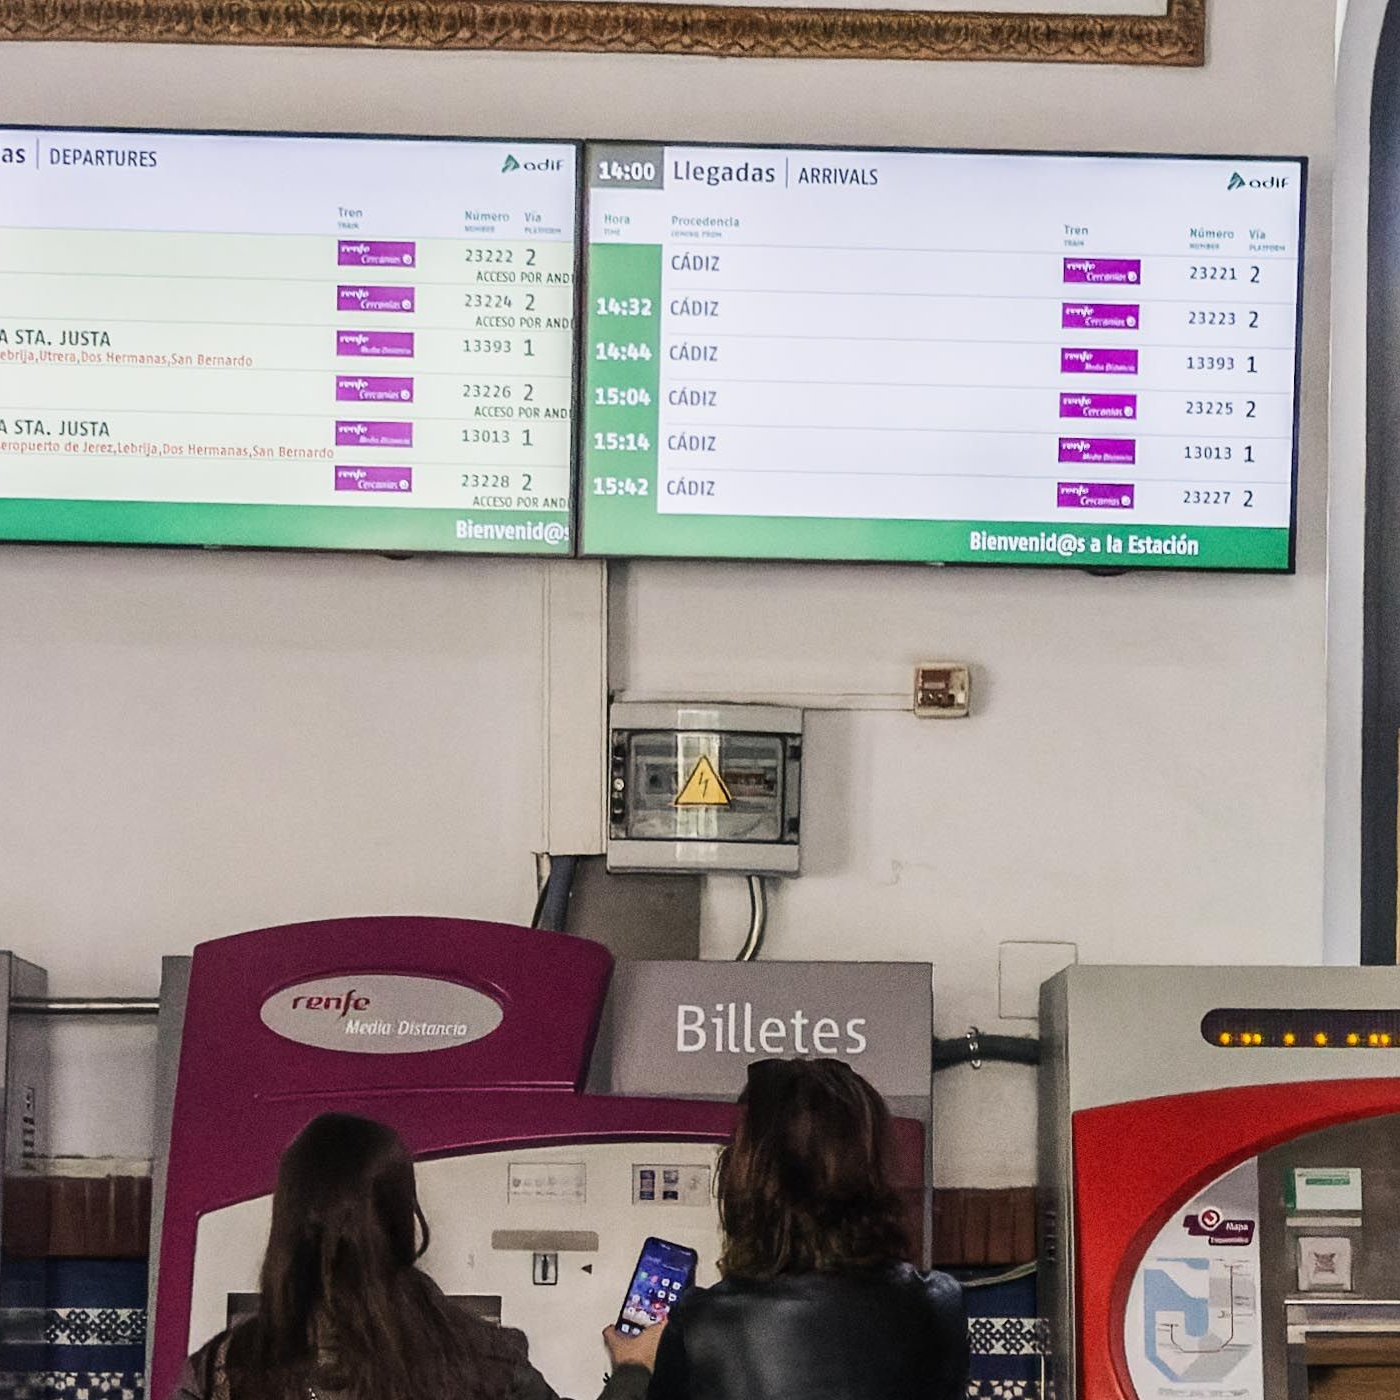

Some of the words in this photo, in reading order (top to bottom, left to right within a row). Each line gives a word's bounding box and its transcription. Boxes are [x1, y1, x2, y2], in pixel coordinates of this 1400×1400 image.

[50, 148, 157, 168] DEPARTURES
[524, 158, 565, 172] adif
[599, 161, 656, 180] 14:00
[673, 161, 775, 186] Llegadas
[798, 167, 878, 186] ARRIVALS
[1249, 176, 1289, 189] adif
[338, 207, 363, 218] Tren
[465, 209, 509, 222] Número
[604, 214, 630, 225] Hora
[671, 216, 740, 228] Procedencia
[1064, 225, 1089, 236] Tren
[1190, 227, 1235, 239] Número
[465, 249, 513, 263] 23222
[526, 249, 536, 266] 2
[671, 252, 720, 272] CÁDIZ
[476, 271, 516, 283] ACCESO
[521, 271, 542, 283] POR
[1190, 267, 1238, 281] 23221
[1250, 266, 1260, 283] 2
[465, 294, 512, 308] 23224
[525, 294, 535, 311] 2
[596, 298, 652, 316] 14:32
[670, 297, 719, 317] CÁDIZ
[476, 316, 515, 328] ACCESO
[520, 316, 541, 329] POR
[1188, 312, 1236, 325] 23223
[1249, 311, 1259, 329] 2
[15, 330, 51, 346] STA.
[60, 330, 111, 347] JUSTA
[463, 339, 512, 353] 13393
[524, 339, 535, 356] 1
[595, 342, 652, 361] 14:44
[669, 342, 718, 362] CÁDIZ
[197, 354, 253, 367] Bernardo
[1187, 357, 1234, 370] 13393
[1247, 356, 1258, 373] 1
[463, 385, 512, 399] 23226
[523, 384, 534, 401] 2
[595, 388, 651, 406] 15:04
[669, 387, 717, 406] CÁDIZ
[474, 406, 514, 418] ACCESO
[519, 407, 540, 418] POR
[1186, 402, 1234, 415] 23225
[1246, 401, 1256, 418] 2
[15, 420, 51, 436] STA.
[59, 421, 110, 437] JUSTA
[461, 430, 510, 443] 13013
[522, 429, 533, 447] 1
[594, 432, 650, 451] 15:14
[668, 432, 716, 452] CÁDIZ
[65, 441, 79, 452] de
[279, 446, 334, 459] Bernardo
[1184, 447, 1232, 460] 13013
[1244, 446, 1255, 463] 1
[461, 475, 510, 488] 23228
[522, 474, 532, 491] 2
[593, 477, 649, 496] 15:42
[667, 477, 715, 497] CÁDIZ
[473, 496, 513, 508] ACCESO
[517, 497, 538, 508] POR
[1184, 491, 1231, 504] 23227
[1243, 490, 1253, 508] 2
[970, 531, 1085, 556] Bienvenid@s
[1090, 538, 1101, 553] a
[1106, 534, 1122, 554] la
[1128, 533, 1199, 556] Estación
[292, 989, 370, 1018] renfe
[345, 1020, 391, 1035] Media
[397, 1020, 467, 1036] Distancia
[677, 1004, 868, 1056] Billetes
[1226, 1222, 1249, 1232] Mapa
